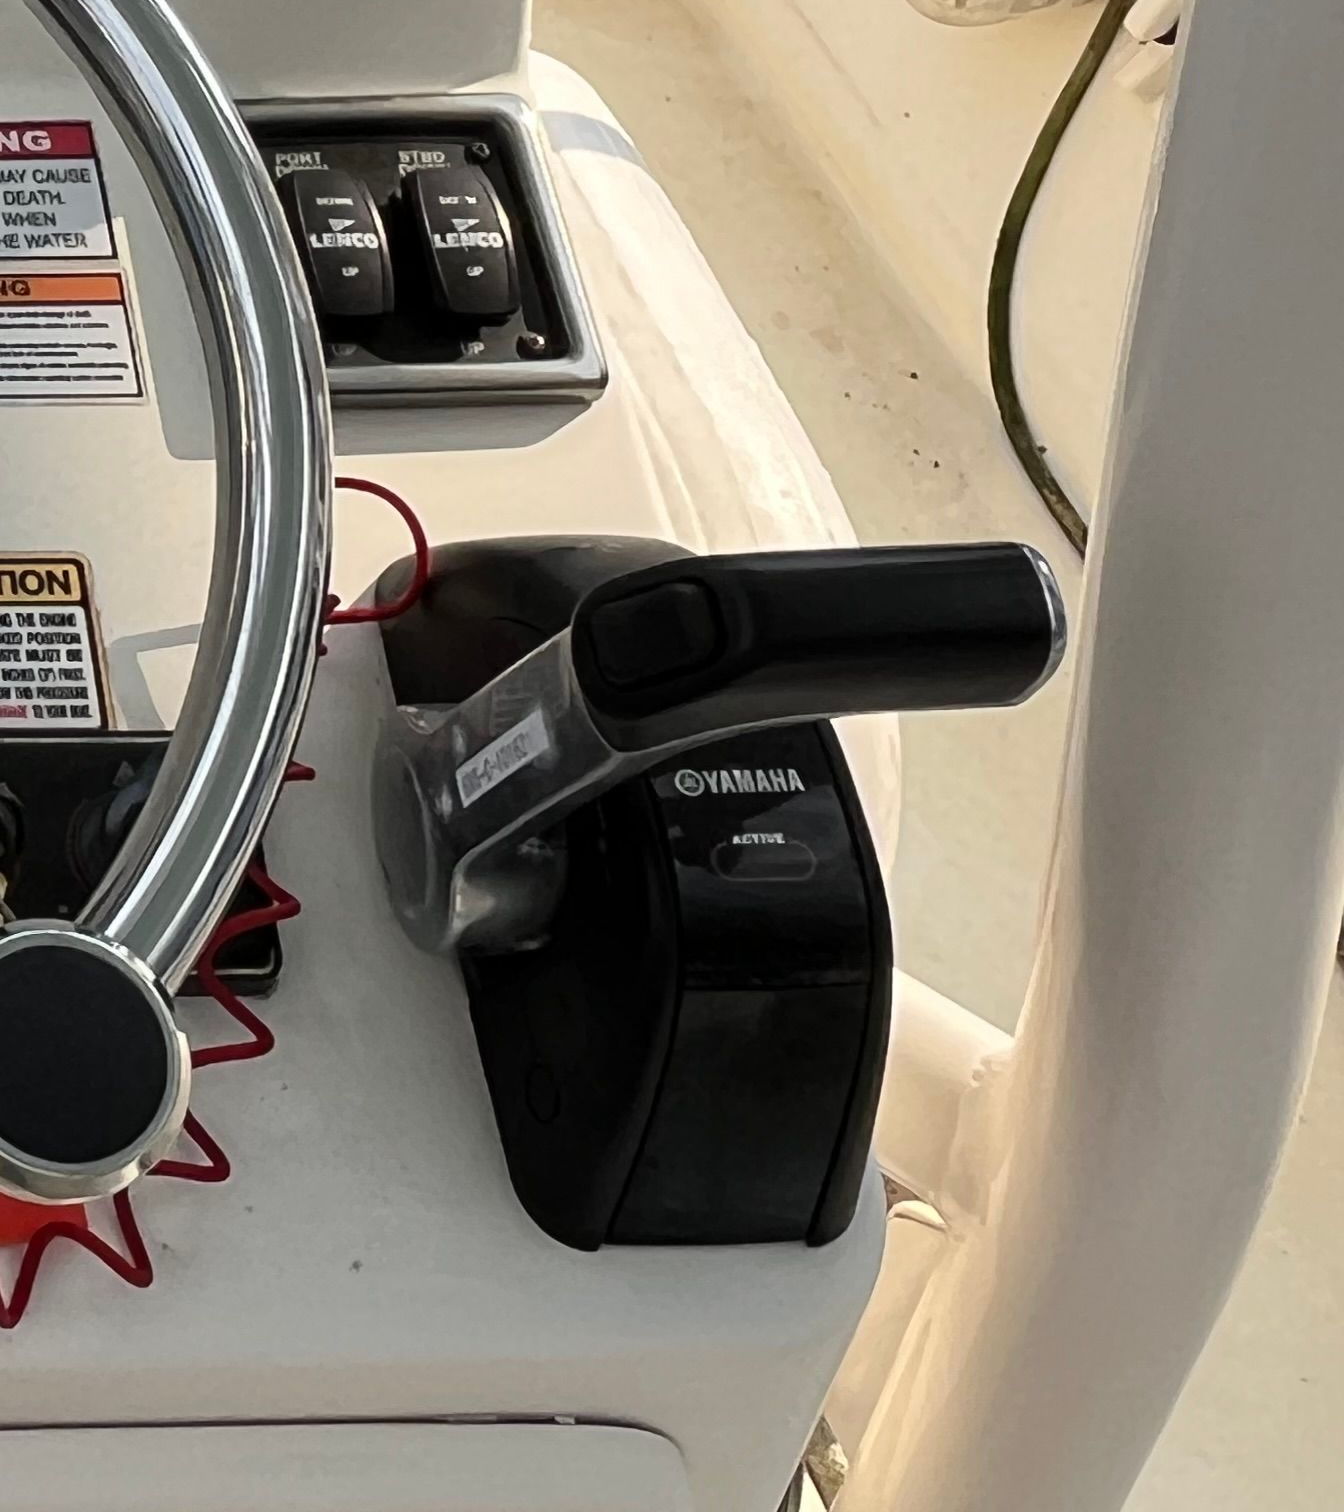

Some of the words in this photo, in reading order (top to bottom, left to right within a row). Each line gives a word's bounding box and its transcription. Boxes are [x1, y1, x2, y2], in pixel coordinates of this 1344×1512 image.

[275, 151, 322, 166] PORT
[31, 168, 92, 184] CAUSE
[1, 211, 57, 227] WHEN
[26, 232, 89, 248] WATER
[309, 232, 380, 249] LENCO
[433, 231, 505, 249] LENCO
[701, 768, 806, 794] YAMAHA
[732, 832, 786, 845] ACTIVE
